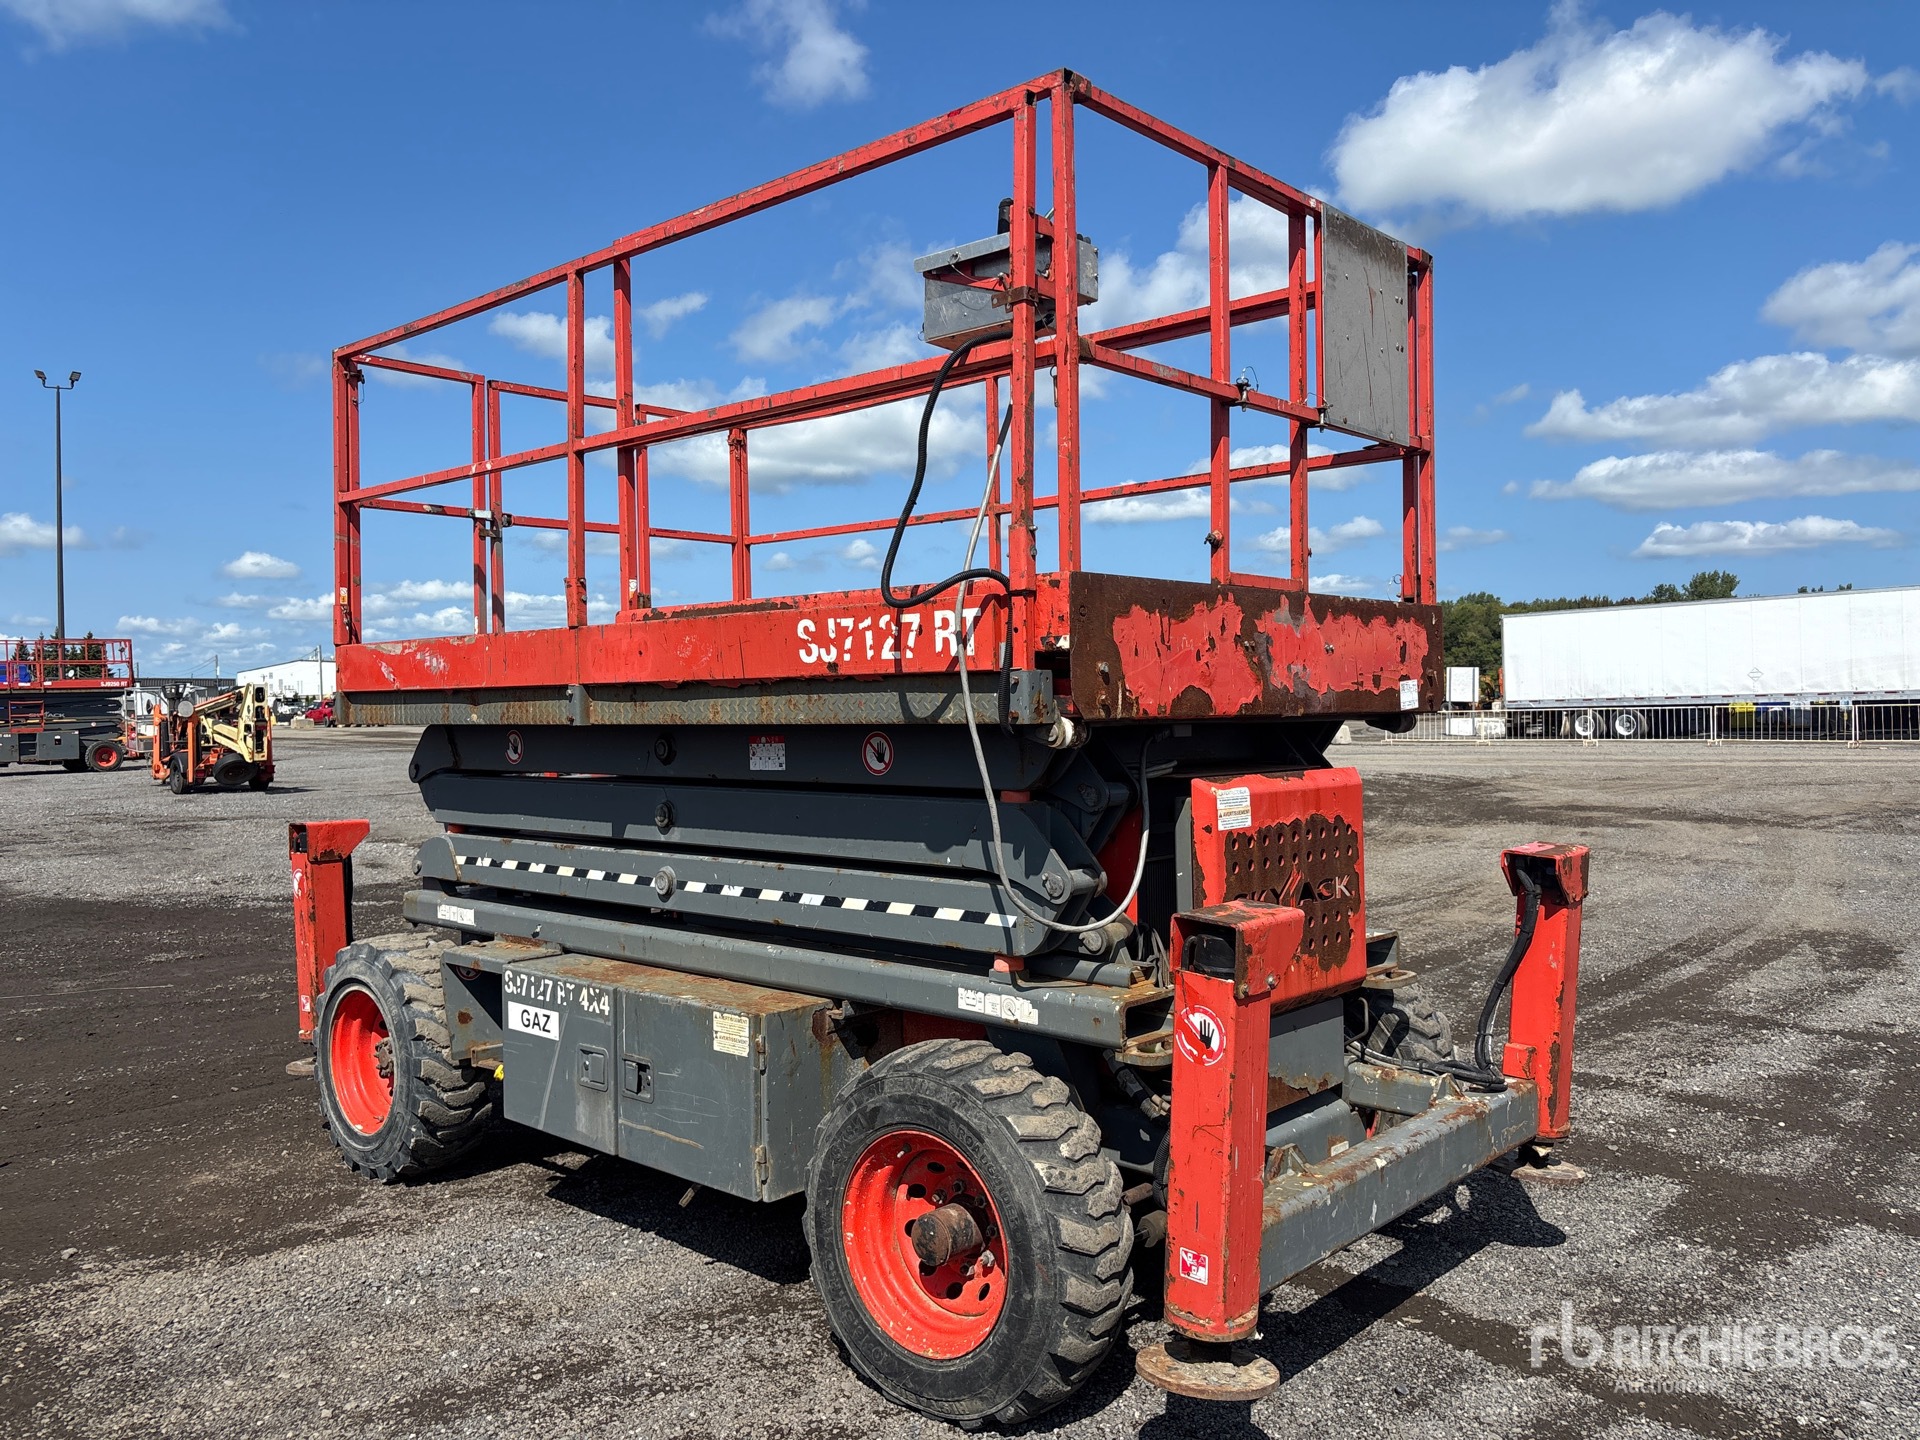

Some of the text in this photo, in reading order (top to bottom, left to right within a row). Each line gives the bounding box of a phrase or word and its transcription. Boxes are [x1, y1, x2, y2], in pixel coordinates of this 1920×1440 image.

[797, 607, 981, 663] SJ7127 RT
[521, 1009, 551, 1034] GAZ
